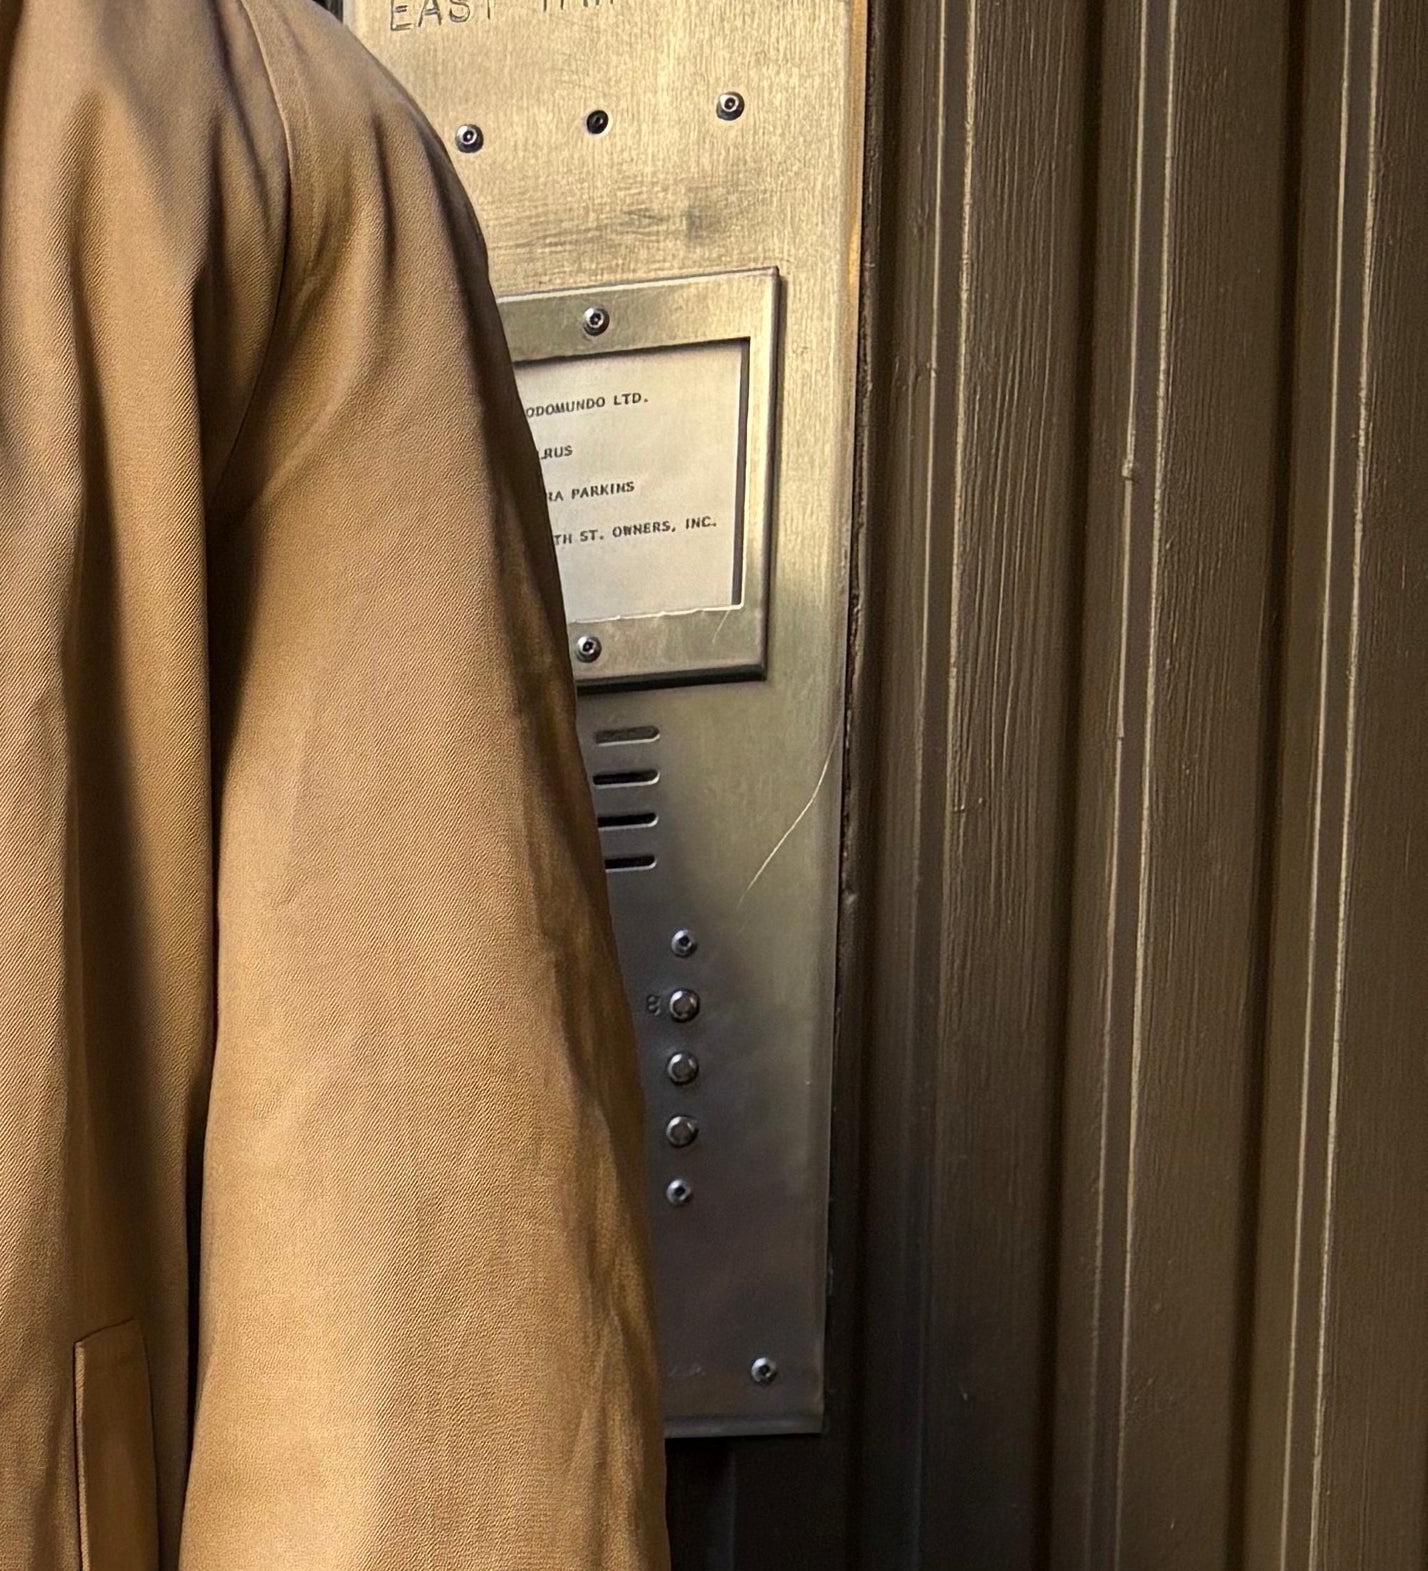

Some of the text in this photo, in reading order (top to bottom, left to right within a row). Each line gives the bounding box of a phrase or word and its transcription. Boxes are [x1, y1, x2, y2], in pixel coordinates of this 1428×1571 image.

[613, 392, 649, 406] LTD.
[541, 444, 573, 460] RUS
[571, 481, 635, 500] PARKINS
[580, 529, 604, 542] ST.
[612, 520, 676, 538] OWNERS,
[685, 516, 717, 530] INC.
